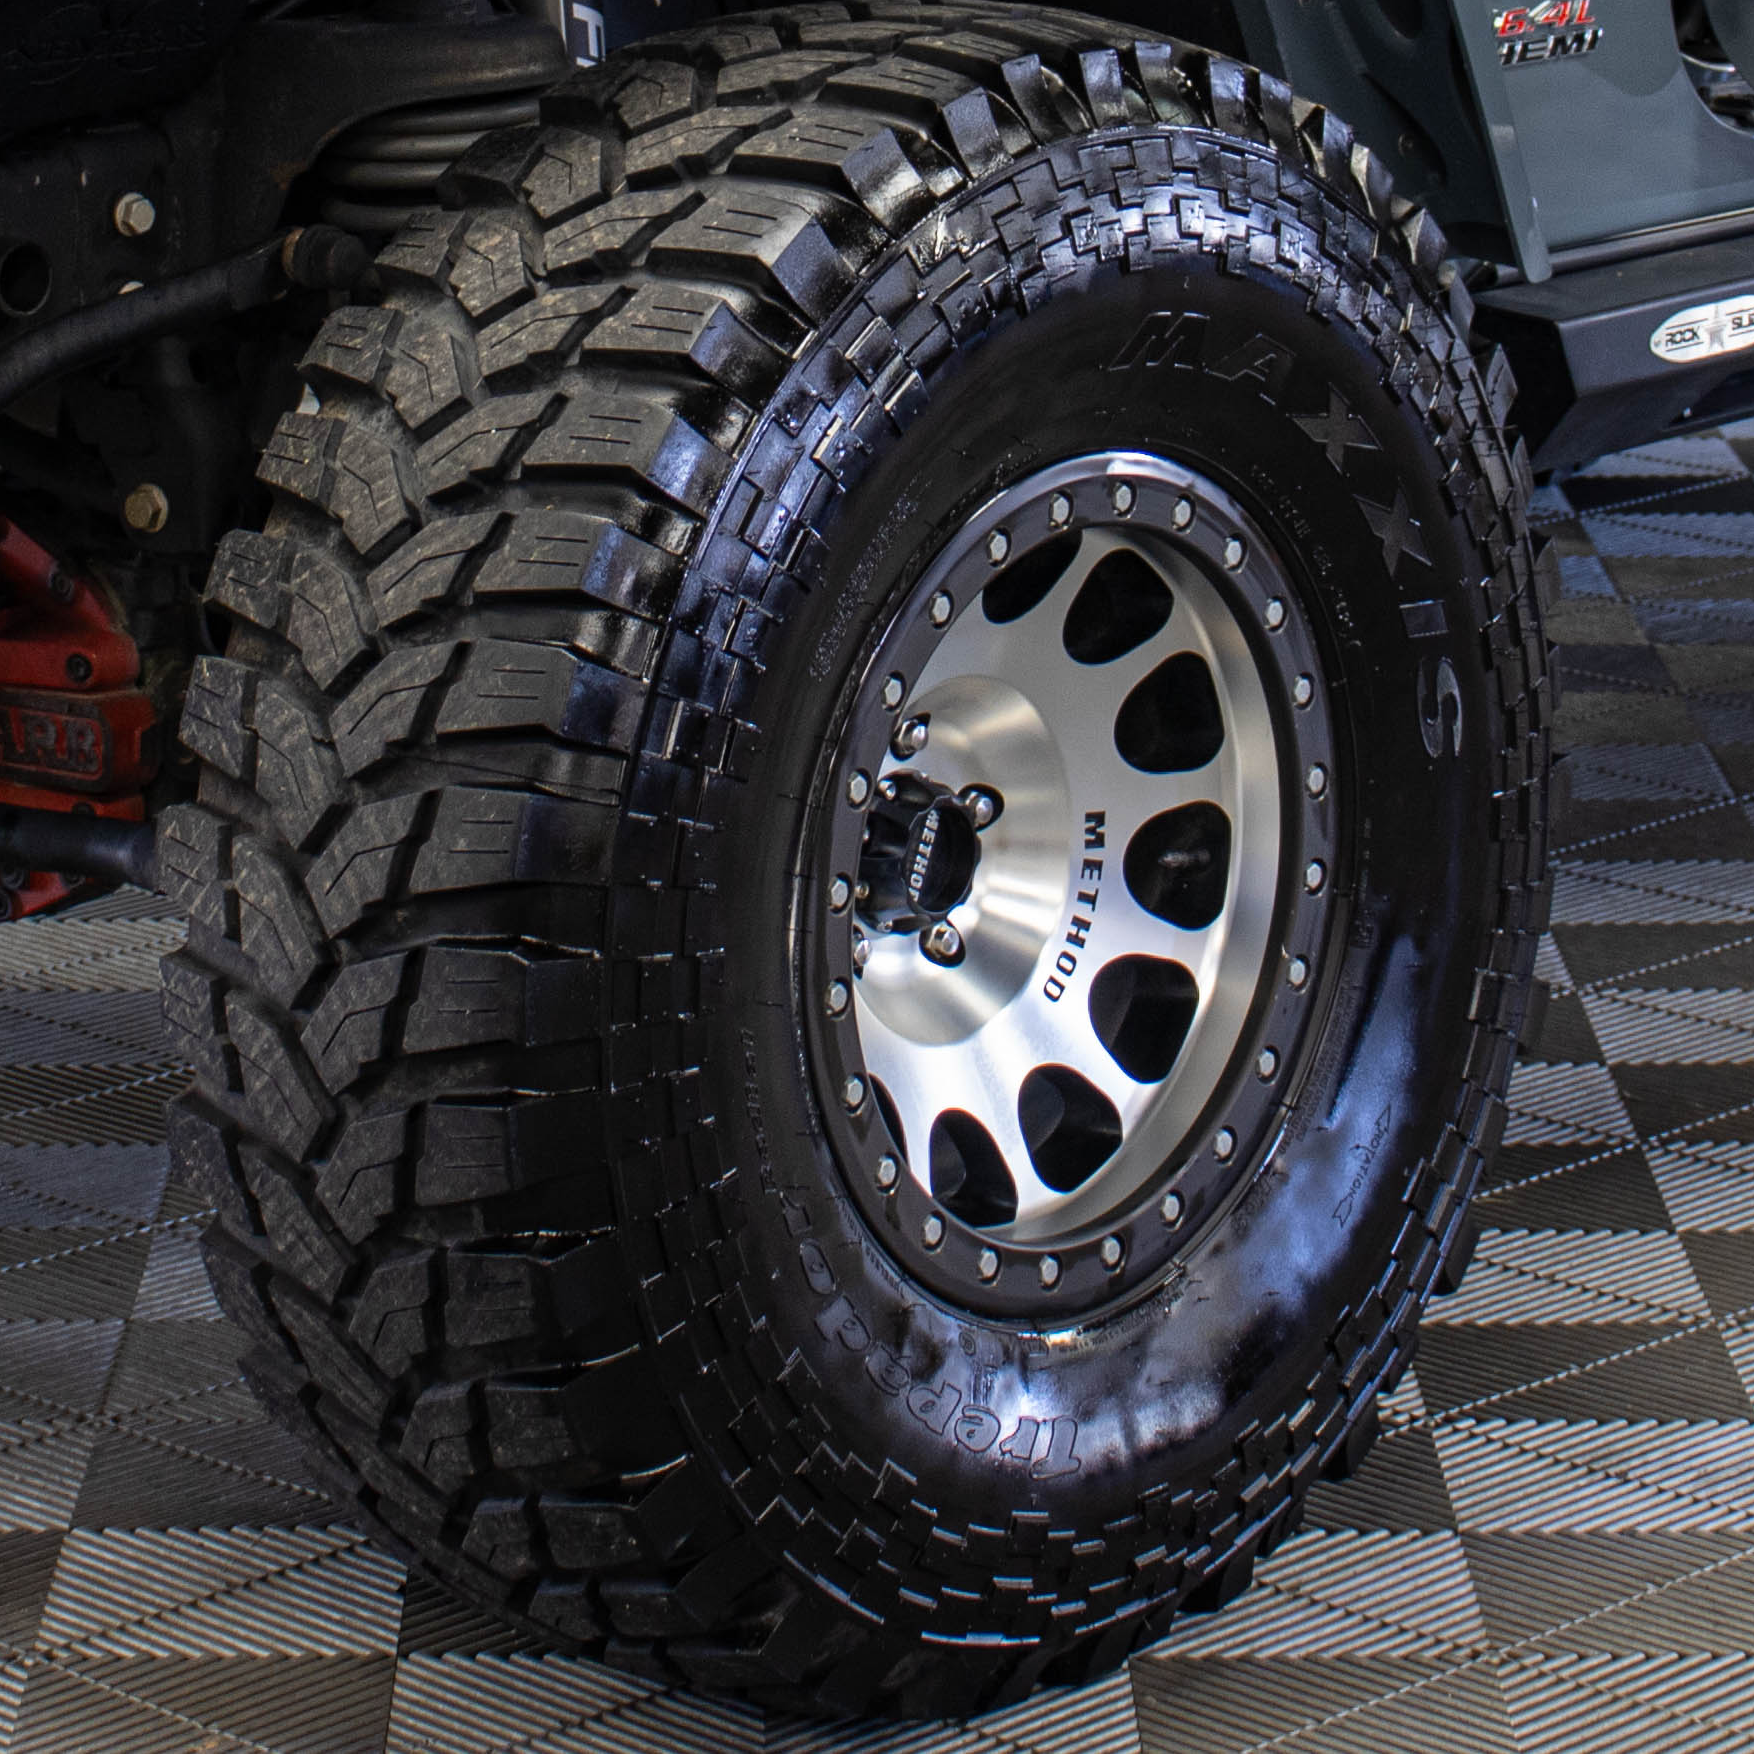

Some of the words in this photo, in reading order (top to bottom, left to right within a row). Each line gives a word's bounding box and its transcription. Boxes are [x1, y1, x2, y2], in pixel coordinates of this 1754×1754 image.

[1664, 325, 1702, 348] ROCK
[1107, 311, 1463, 758] MAXXIS
[1043, 809, 1107, 1003] METHOD
